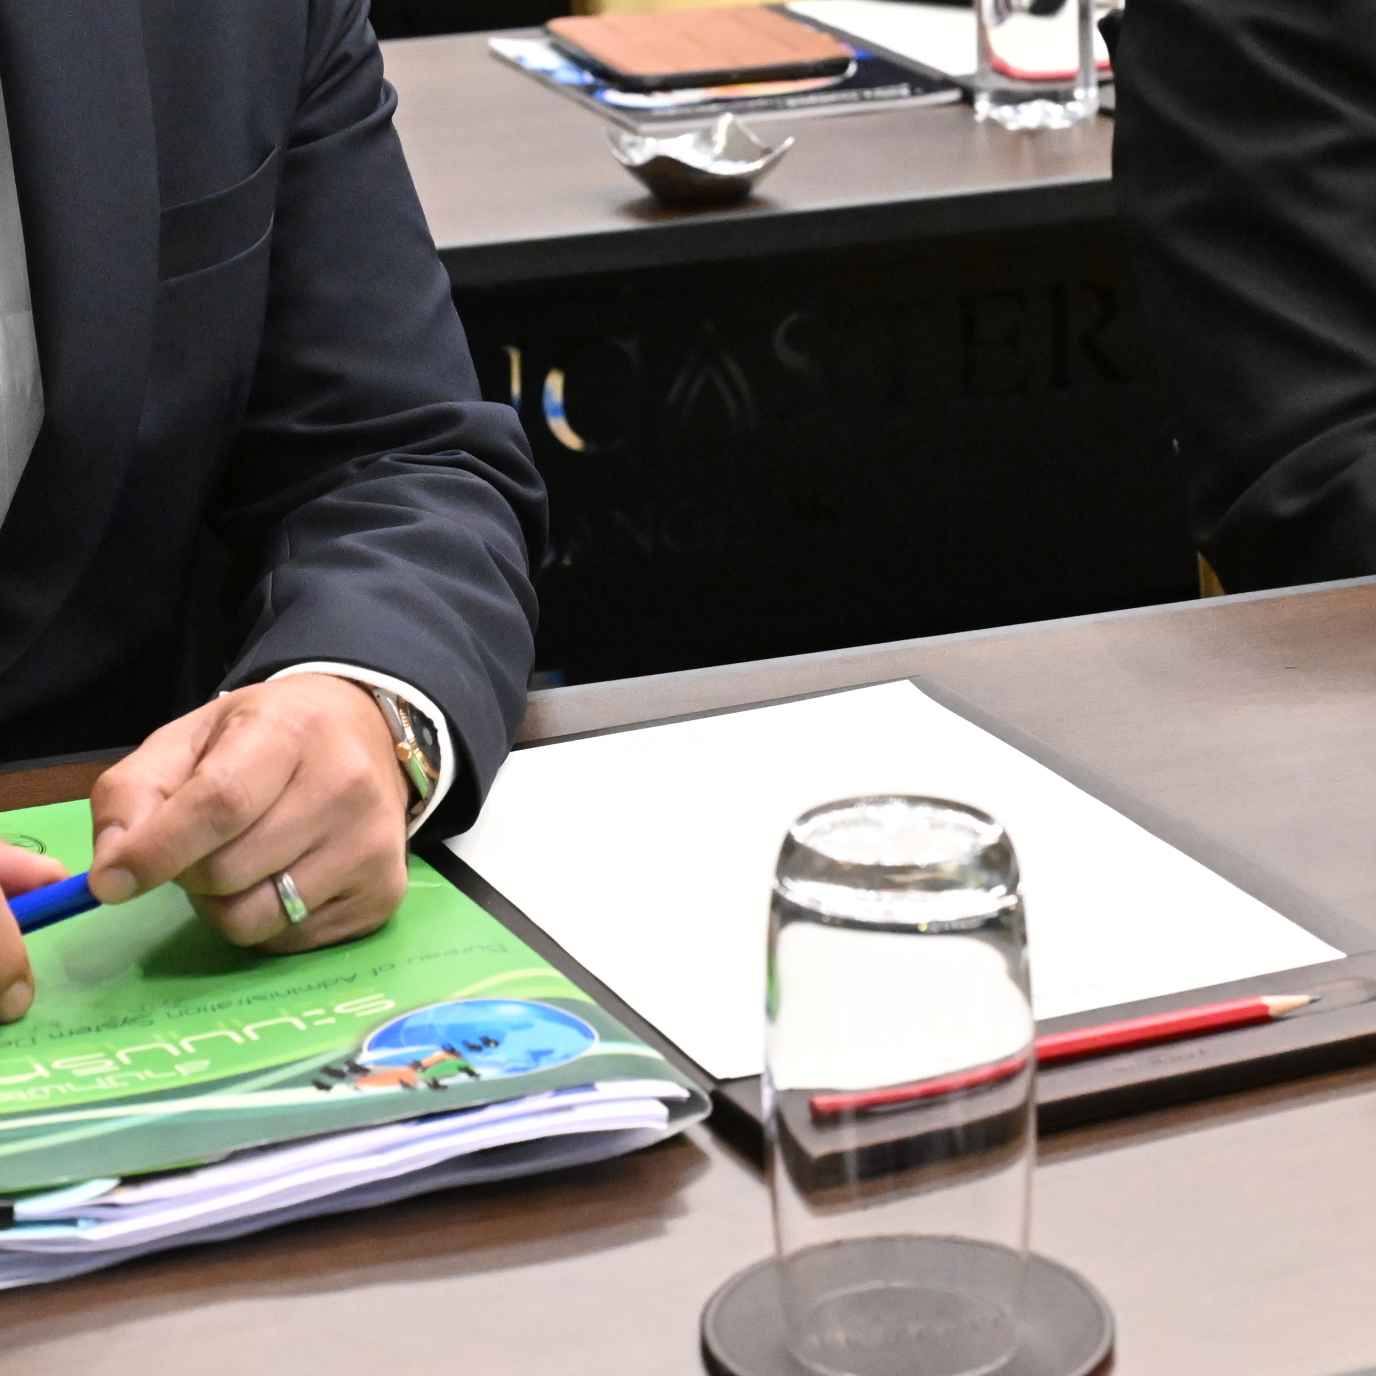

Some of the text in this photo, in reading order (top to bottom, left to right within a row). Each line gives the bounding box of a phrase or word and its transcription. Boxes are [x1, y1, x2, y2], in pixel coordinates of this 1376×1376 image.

[406, 943, 507, 967] Bureau
[371, 961, 396, 977] of
[166, 972, 358, 1020] Administration
[48, 1012, 155, 1041] System
